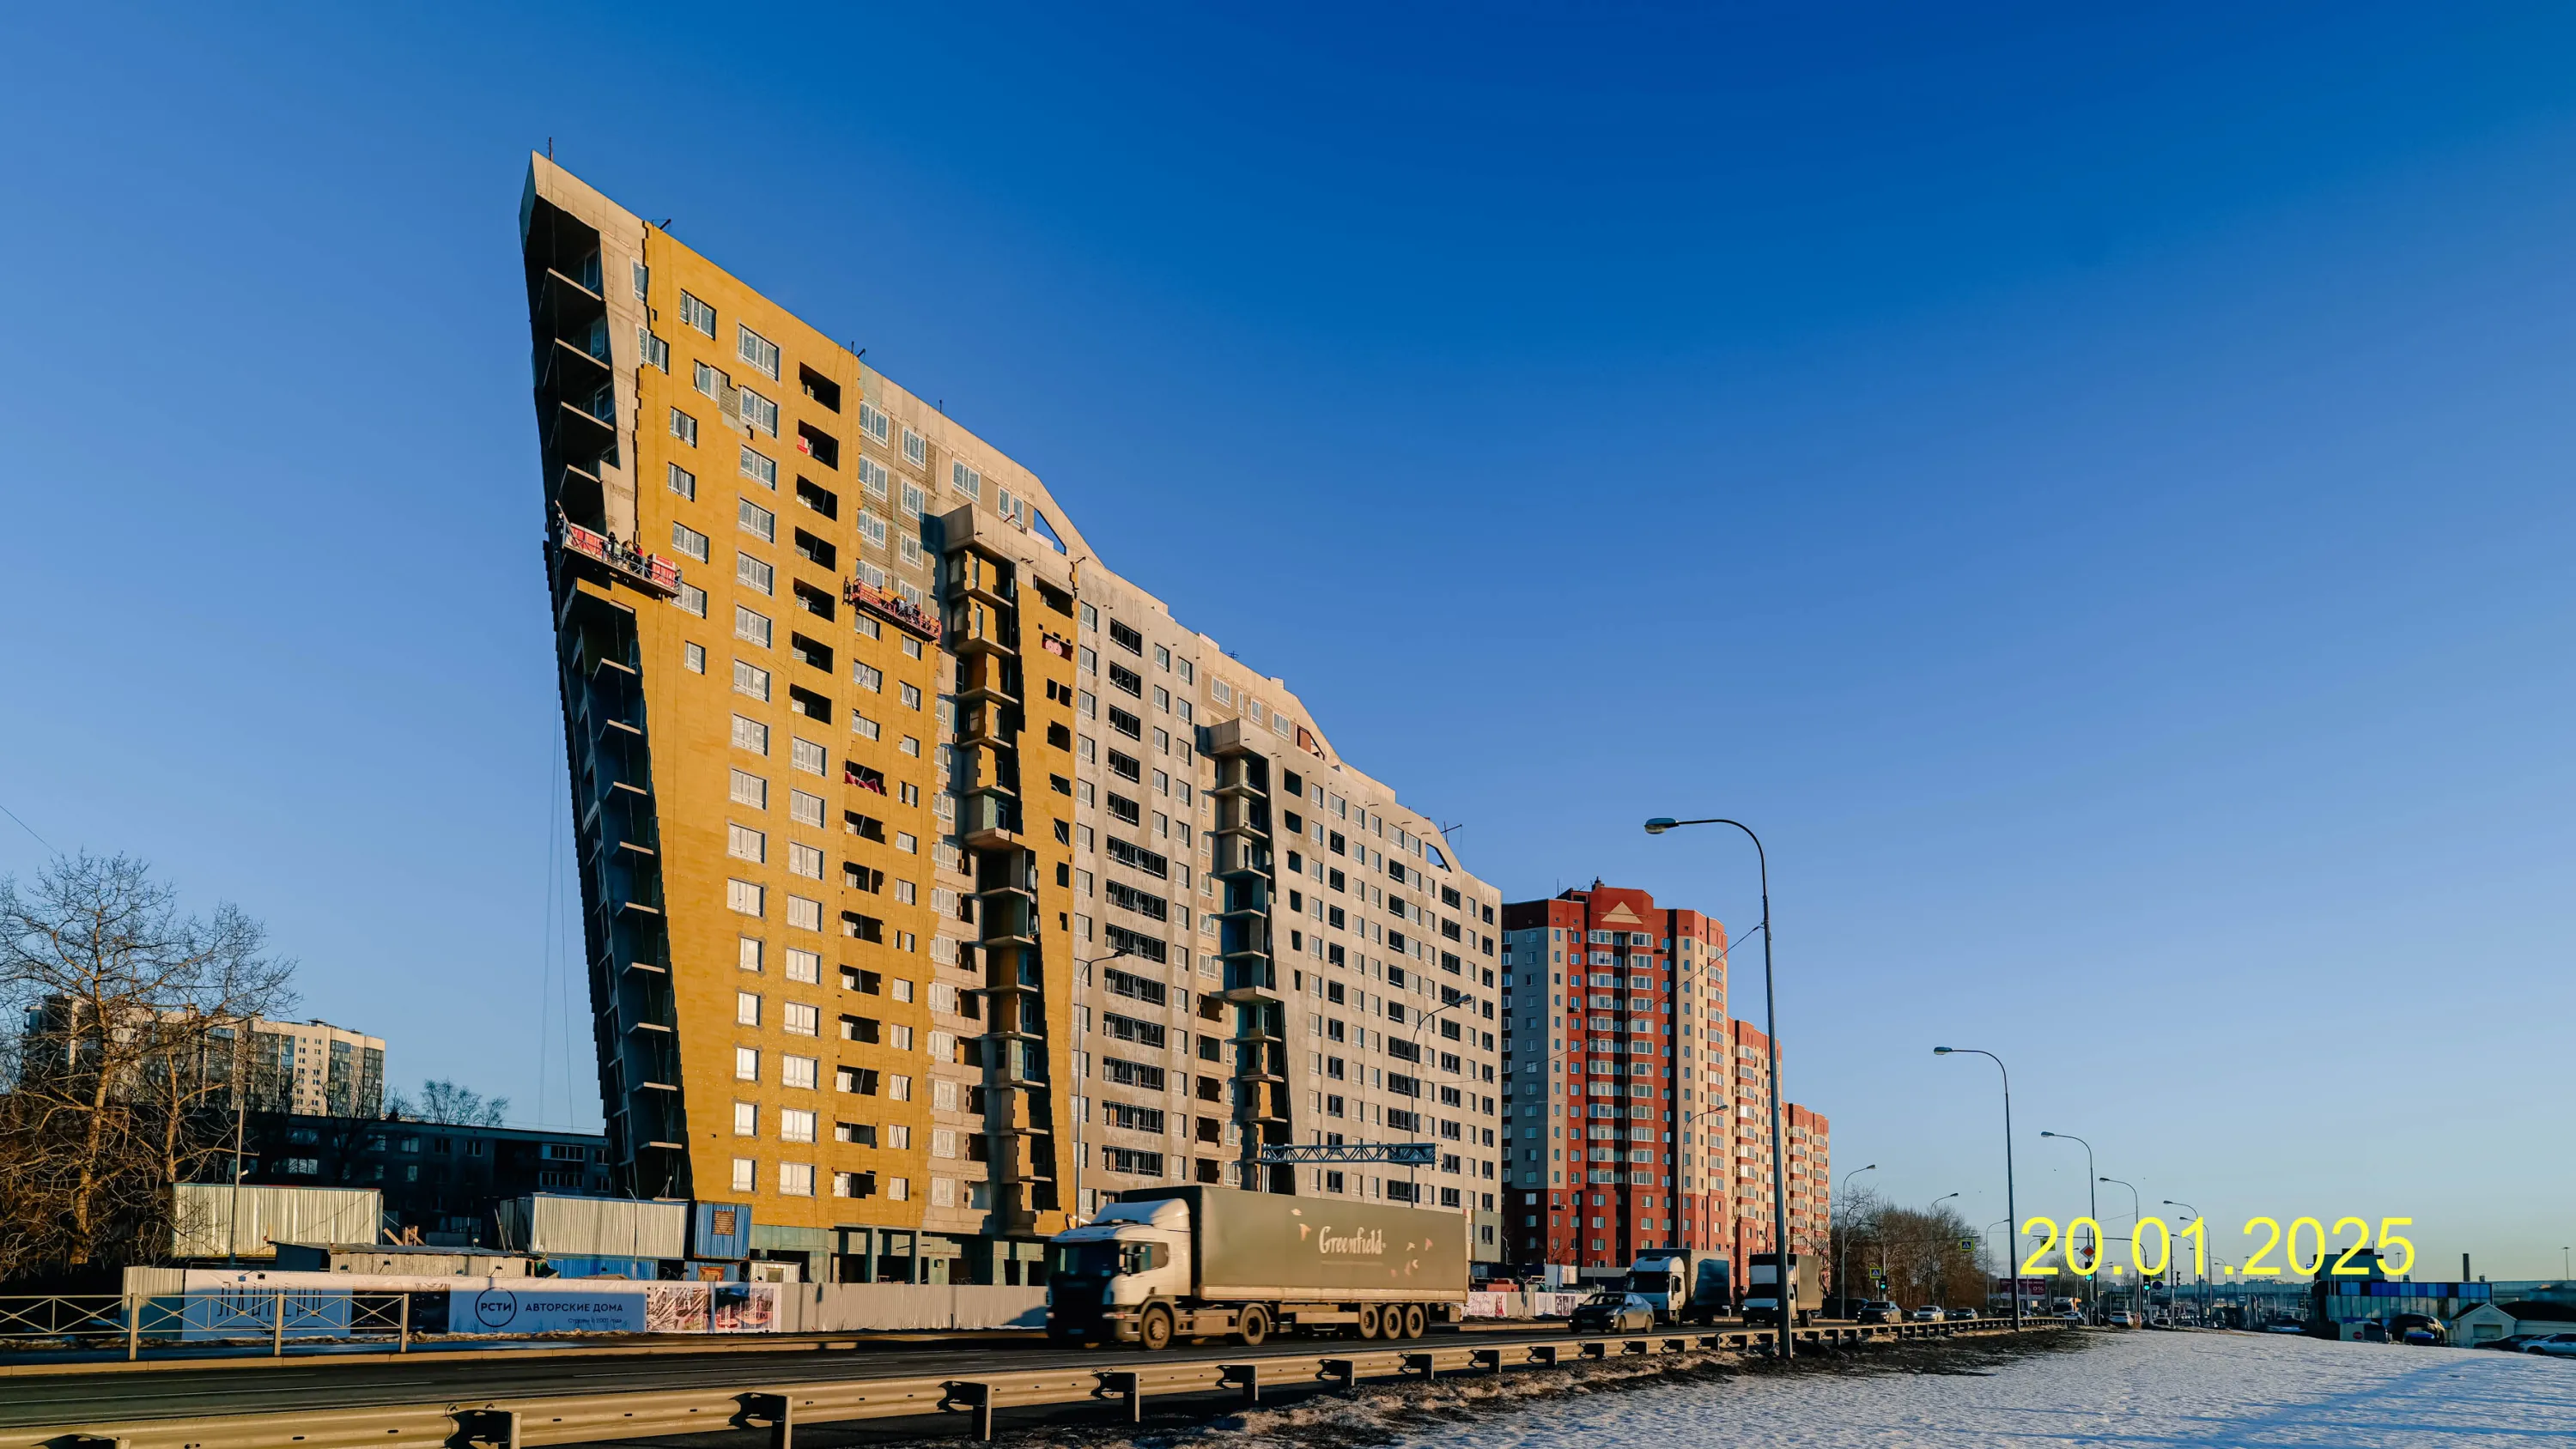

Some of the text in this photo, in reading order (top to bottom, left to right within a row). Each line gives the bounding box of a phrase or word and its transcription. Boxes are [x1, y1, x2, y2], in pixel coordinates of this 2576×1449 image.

[1319, 1226, 1382, 1255] Greenfield
[481, 1302, 512, 1312] РСТИ
[525, 1303, 623, 1313] АВТОРСКИЕ ДОМА
